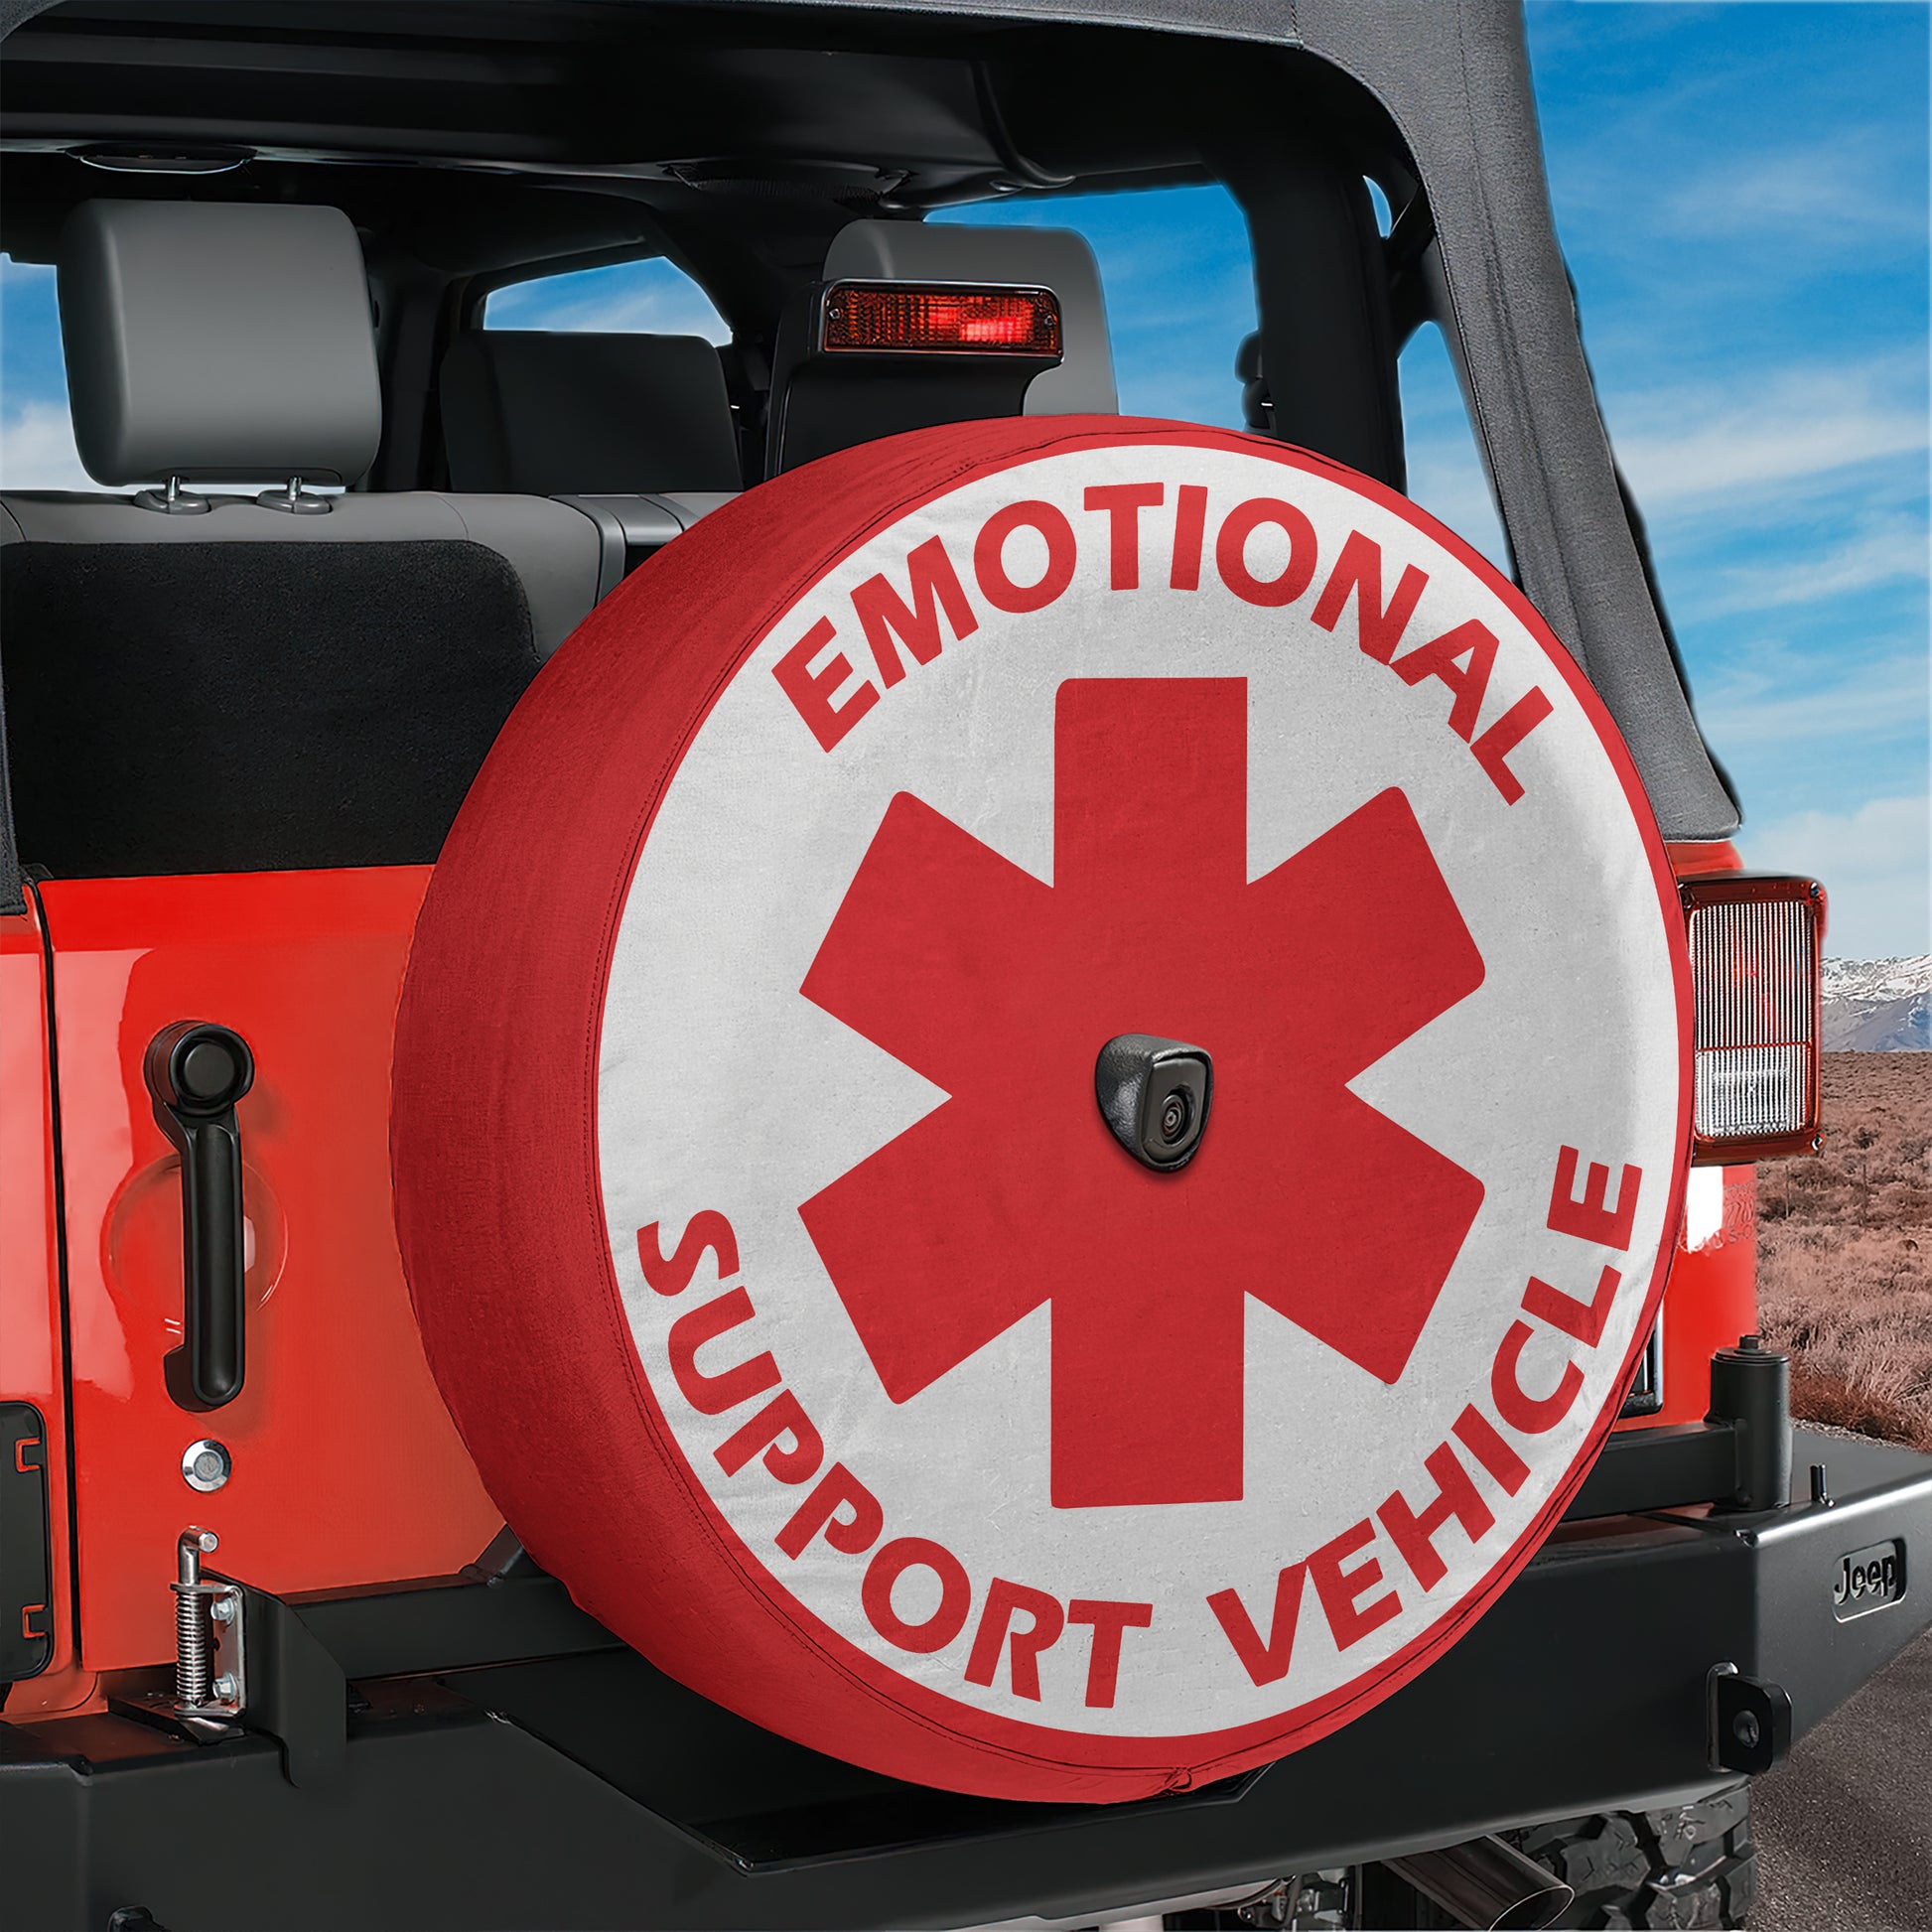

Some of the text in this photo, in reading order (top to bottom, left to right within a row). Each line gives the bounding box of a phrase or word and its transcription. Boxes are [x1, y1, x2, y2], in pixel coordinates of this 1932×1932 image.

[772, 483, 1553, 805] EMOTIONAL
[637, 1146, 1642, 1708] SUPPORT VEHICLE
[1834, 1555, 1896, 1605] Jeep
